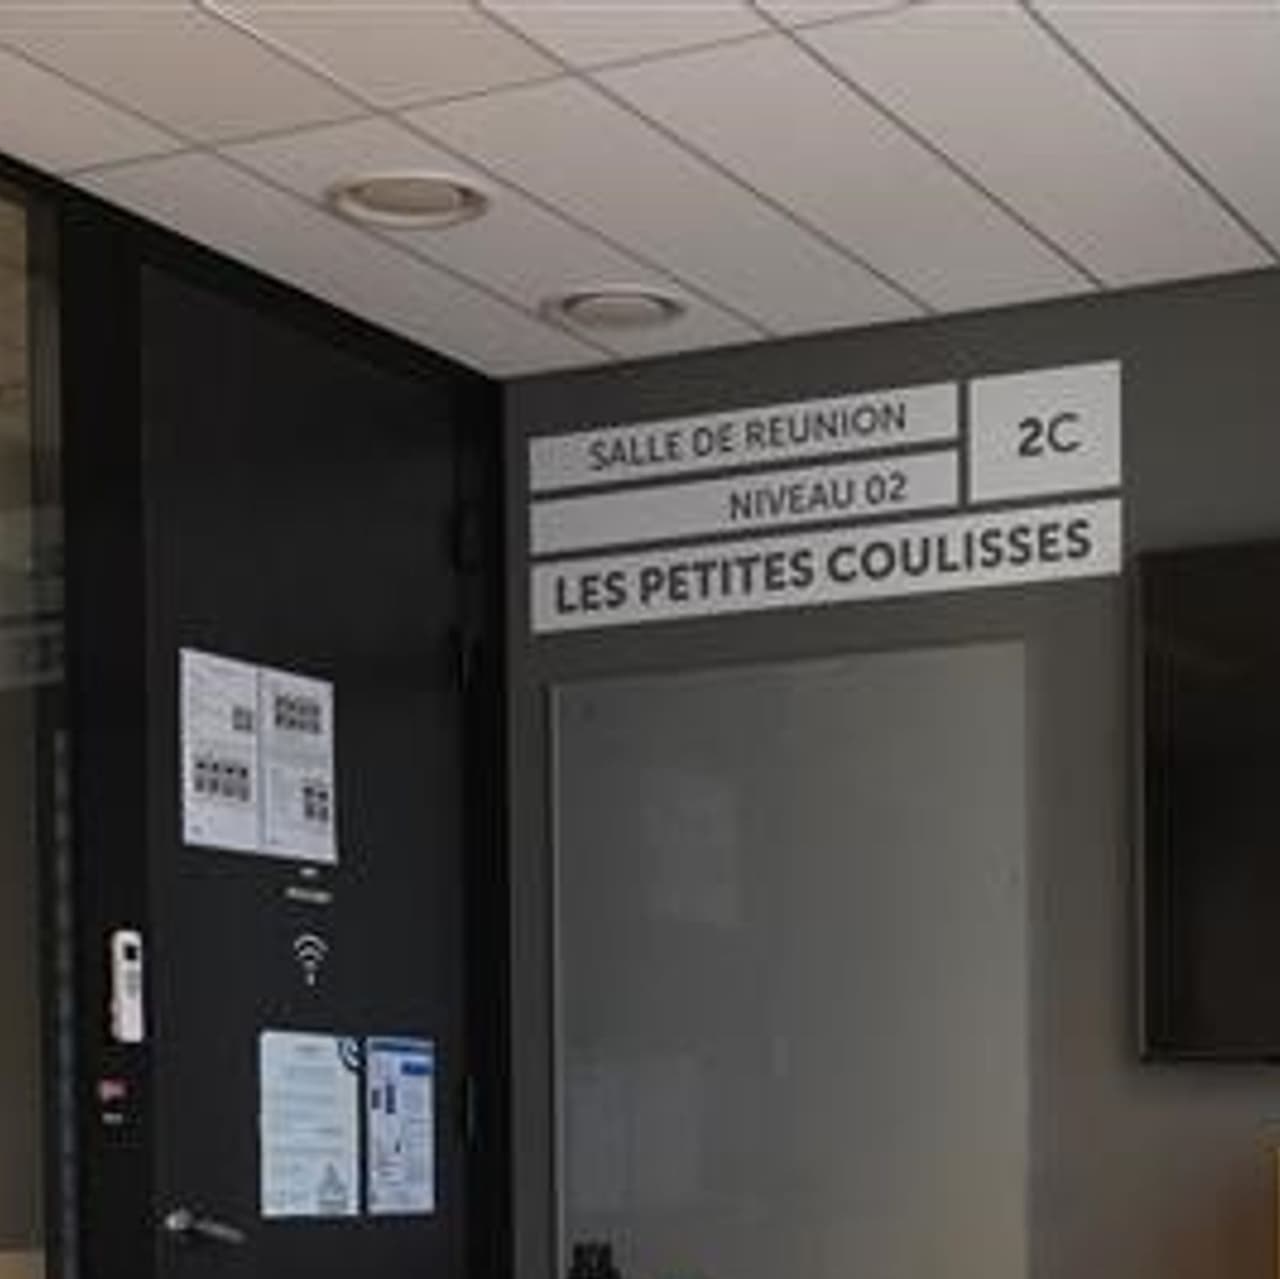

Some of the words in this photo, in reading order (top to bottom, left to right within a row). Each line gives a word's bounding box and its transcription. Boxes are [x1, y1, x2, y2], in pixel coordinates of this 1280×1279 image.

[588, 429, 682, 471] SALLE
[692, 423, 734, 457] DE
[1018, 413, 1082, 457] 2C
[728, 482, 853, 522] NIVEAU
[864, 473, 909, 505] 02
[555, 571, 627, 616] LES
[639, 549, 815, 602] PETITES
[826, 518, 1093, 586] COULISSES
